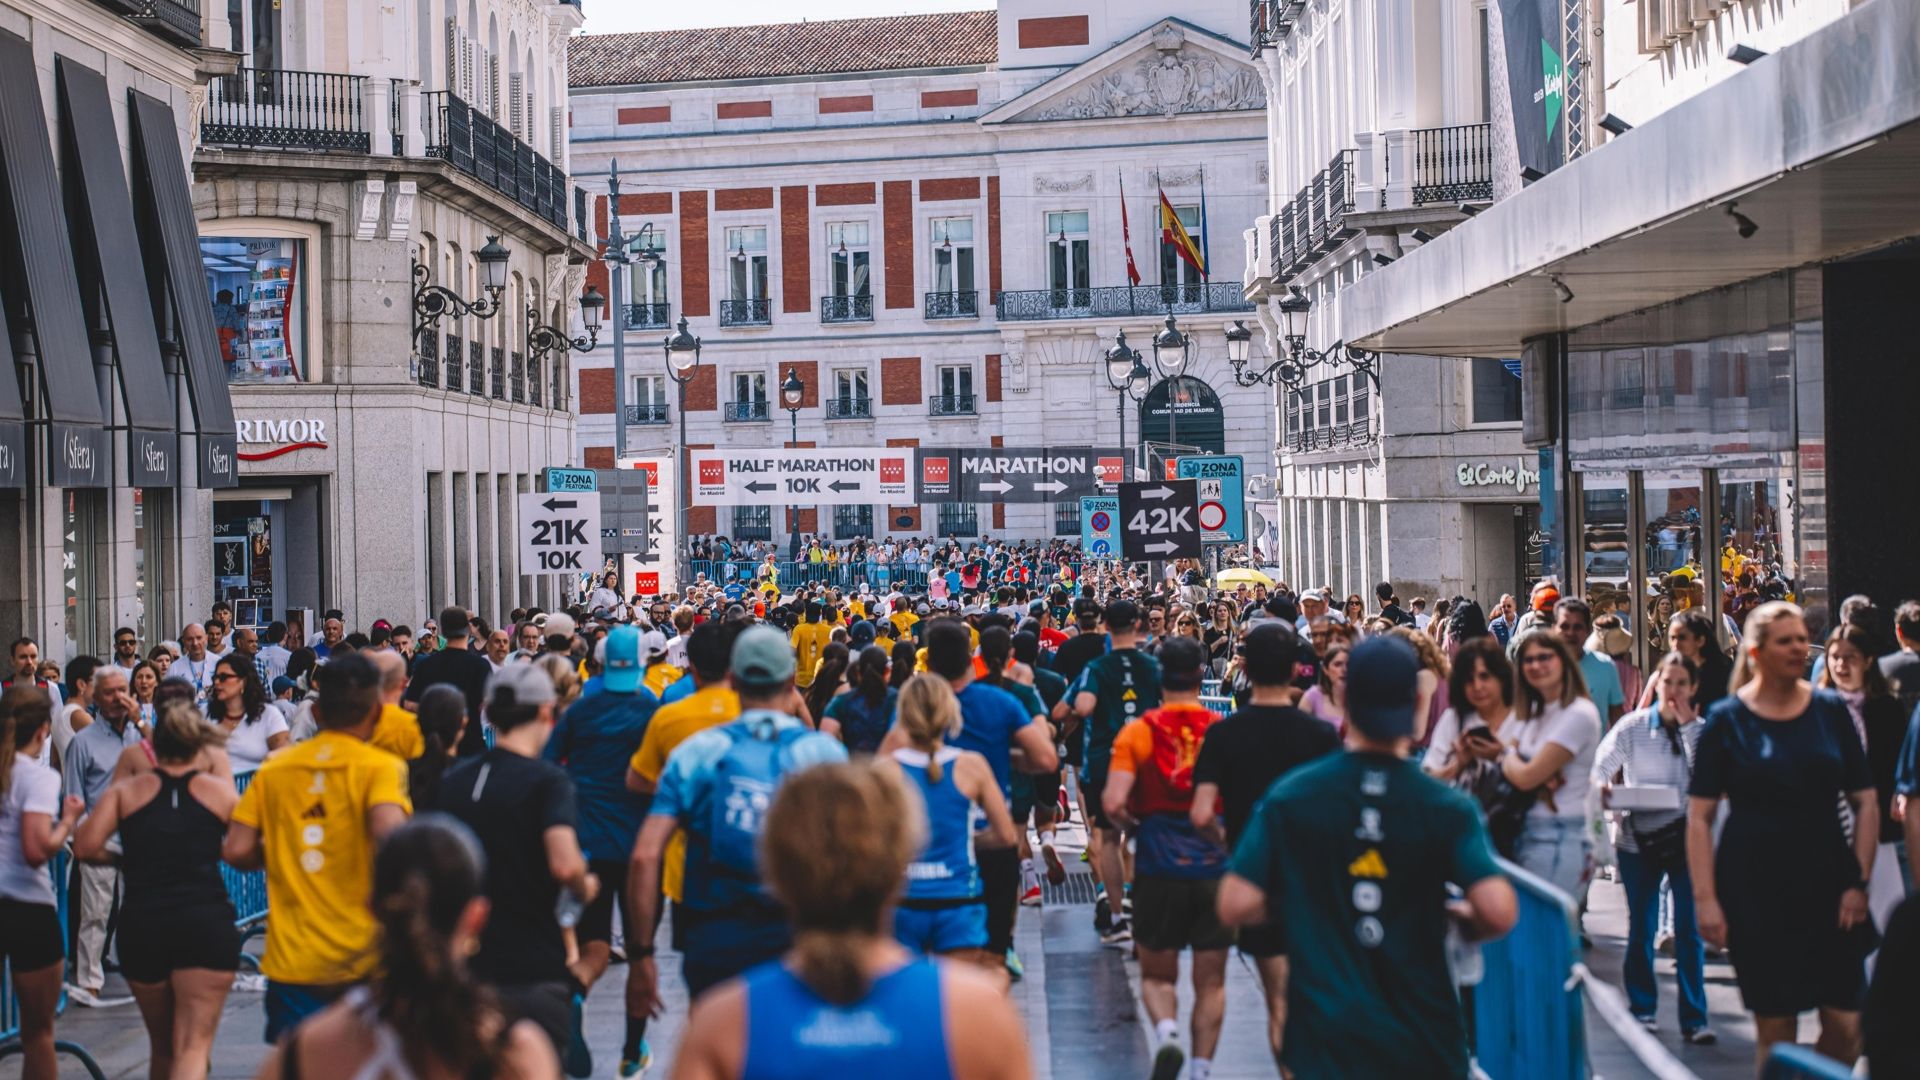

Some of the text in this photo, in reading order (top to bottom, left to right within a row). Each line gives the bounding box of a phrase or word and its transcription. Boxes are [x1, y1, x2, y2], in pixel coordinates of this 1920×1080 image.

[250, 241, 276, 250] PRIMOR
[235, 419, 328, 443] RIMOR
[729, 459, 875, 472] HALF MARATHON
[961, 457, 1086, 474] MARATHON
[1201, 463, 1237, 472] ZONA
[565, 474, 593, 485] ZONA
[1457, 463, 1476, 486] El
[1475, 463, 1516, 486] Corte
[785, 478, 821, 493] 10K
[649, 518, 663, 535] K
[1127, 506, 1195, 535] 42K
[531, 519, 590, 545] 21K
[649, 537, 660, 549] K
[537, 550, 583, 570] 10K
